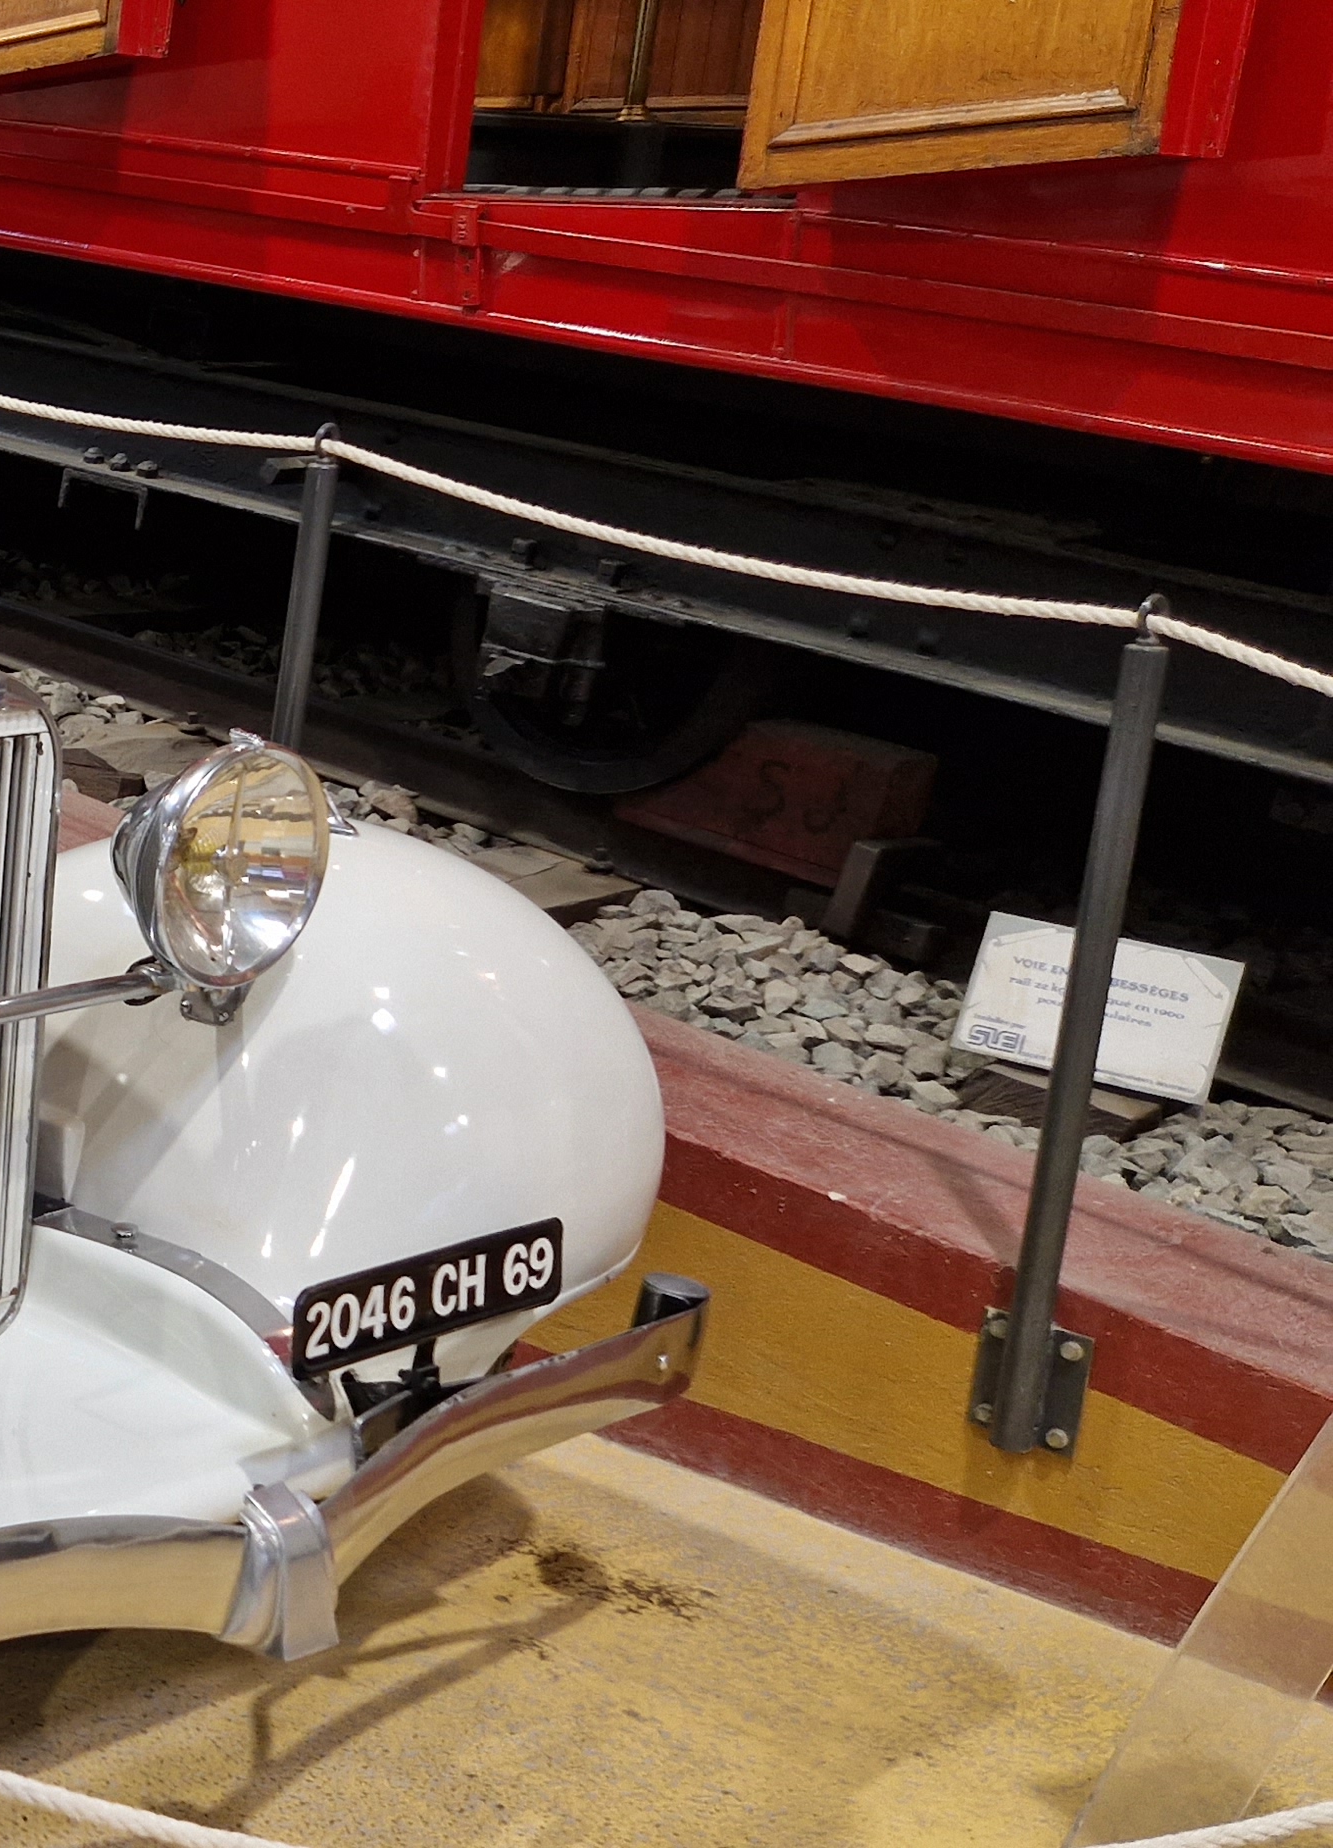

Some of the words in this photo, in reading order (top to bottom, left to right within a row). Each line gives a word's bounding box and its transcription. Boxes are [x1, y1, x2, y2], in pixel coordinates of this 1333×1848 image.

[1013, 955, 1048, 971] VOIE
[1009, 975, 1033, 988] rail
[1134, 1004, 1151, 1014] en
[1153, 1007, 1186, 1021] 1900
[304, 1275, 416, 1360] 2046
[431, 1252, 488, 1317] CH
[502, 1236, 555, 1297] 69
